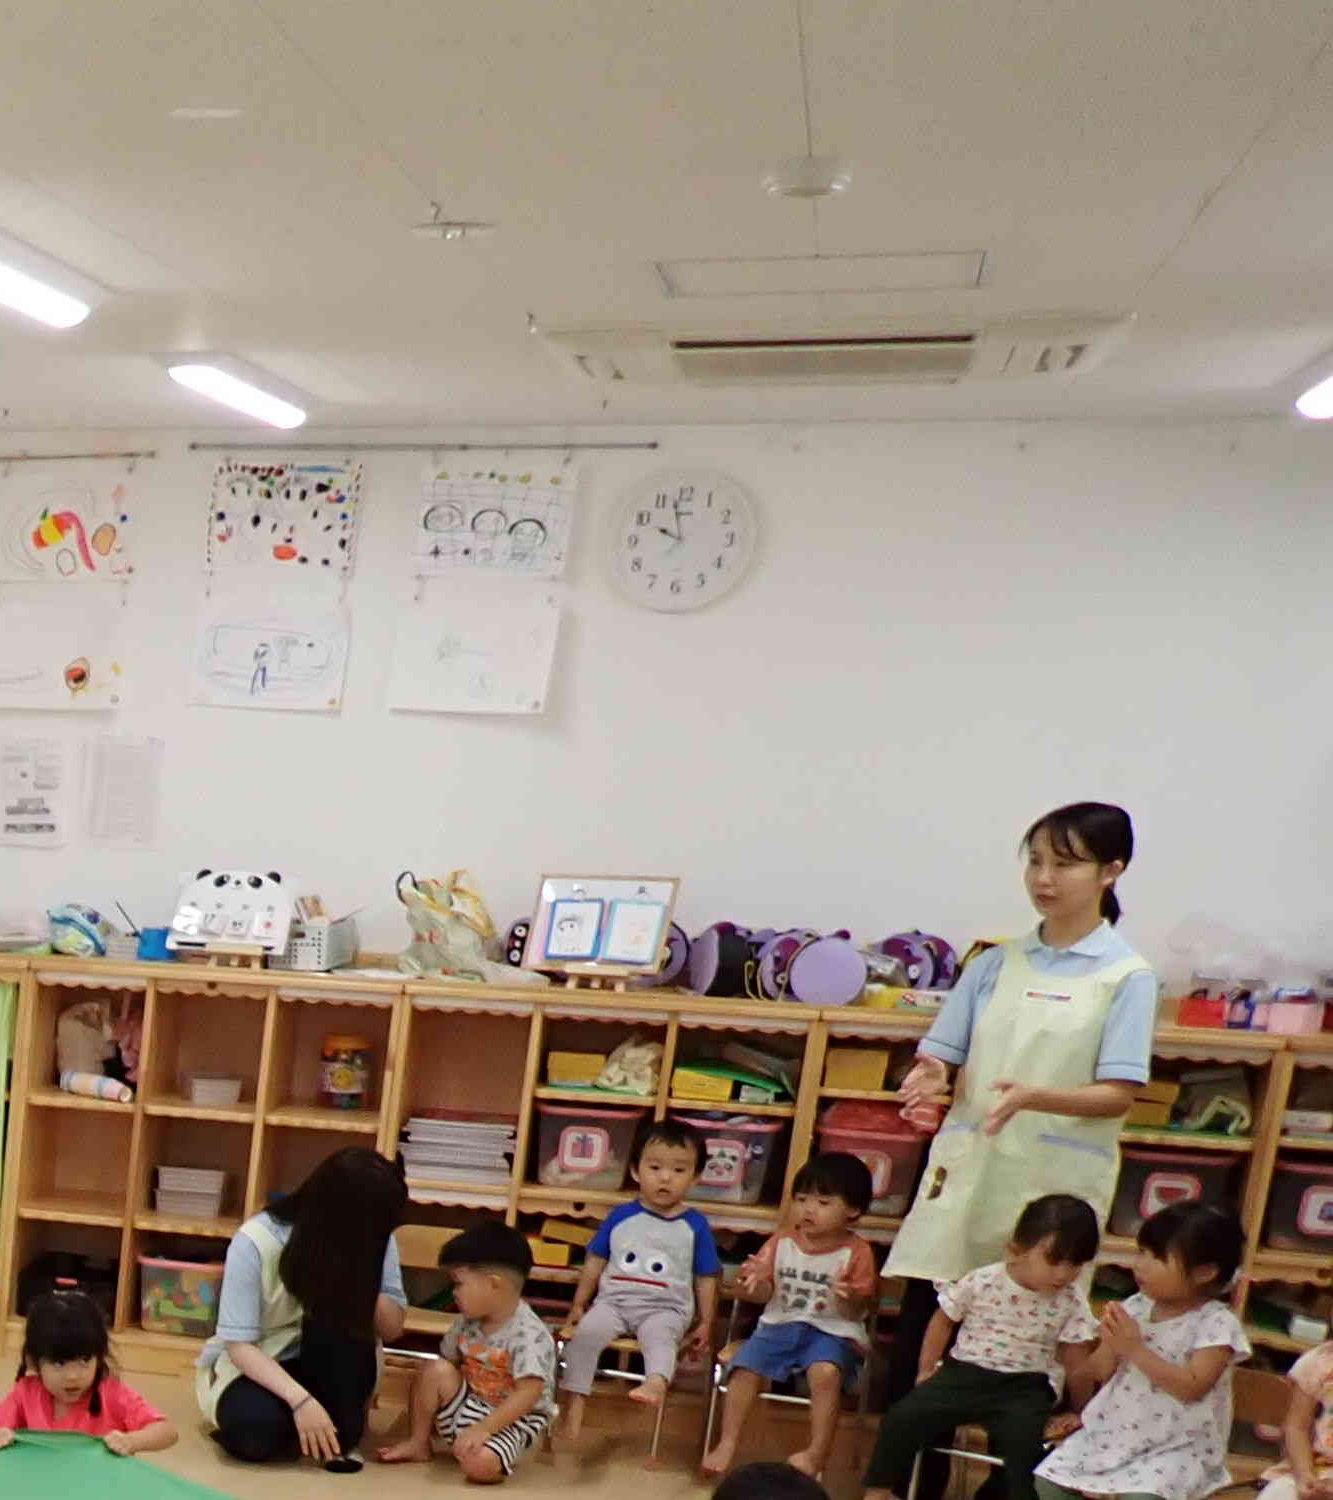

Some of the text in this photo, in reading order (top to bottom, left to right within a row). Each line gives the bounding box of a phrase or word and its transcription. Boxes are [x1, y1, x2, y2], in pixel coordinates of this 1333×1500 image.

[706, 490, 714, 508] 1
[721, 508, 732, 525] 2
[631, 557, 643, 573] 8
[646, 573, 658, 590] 7
[669, 579, 681, 595] 6
